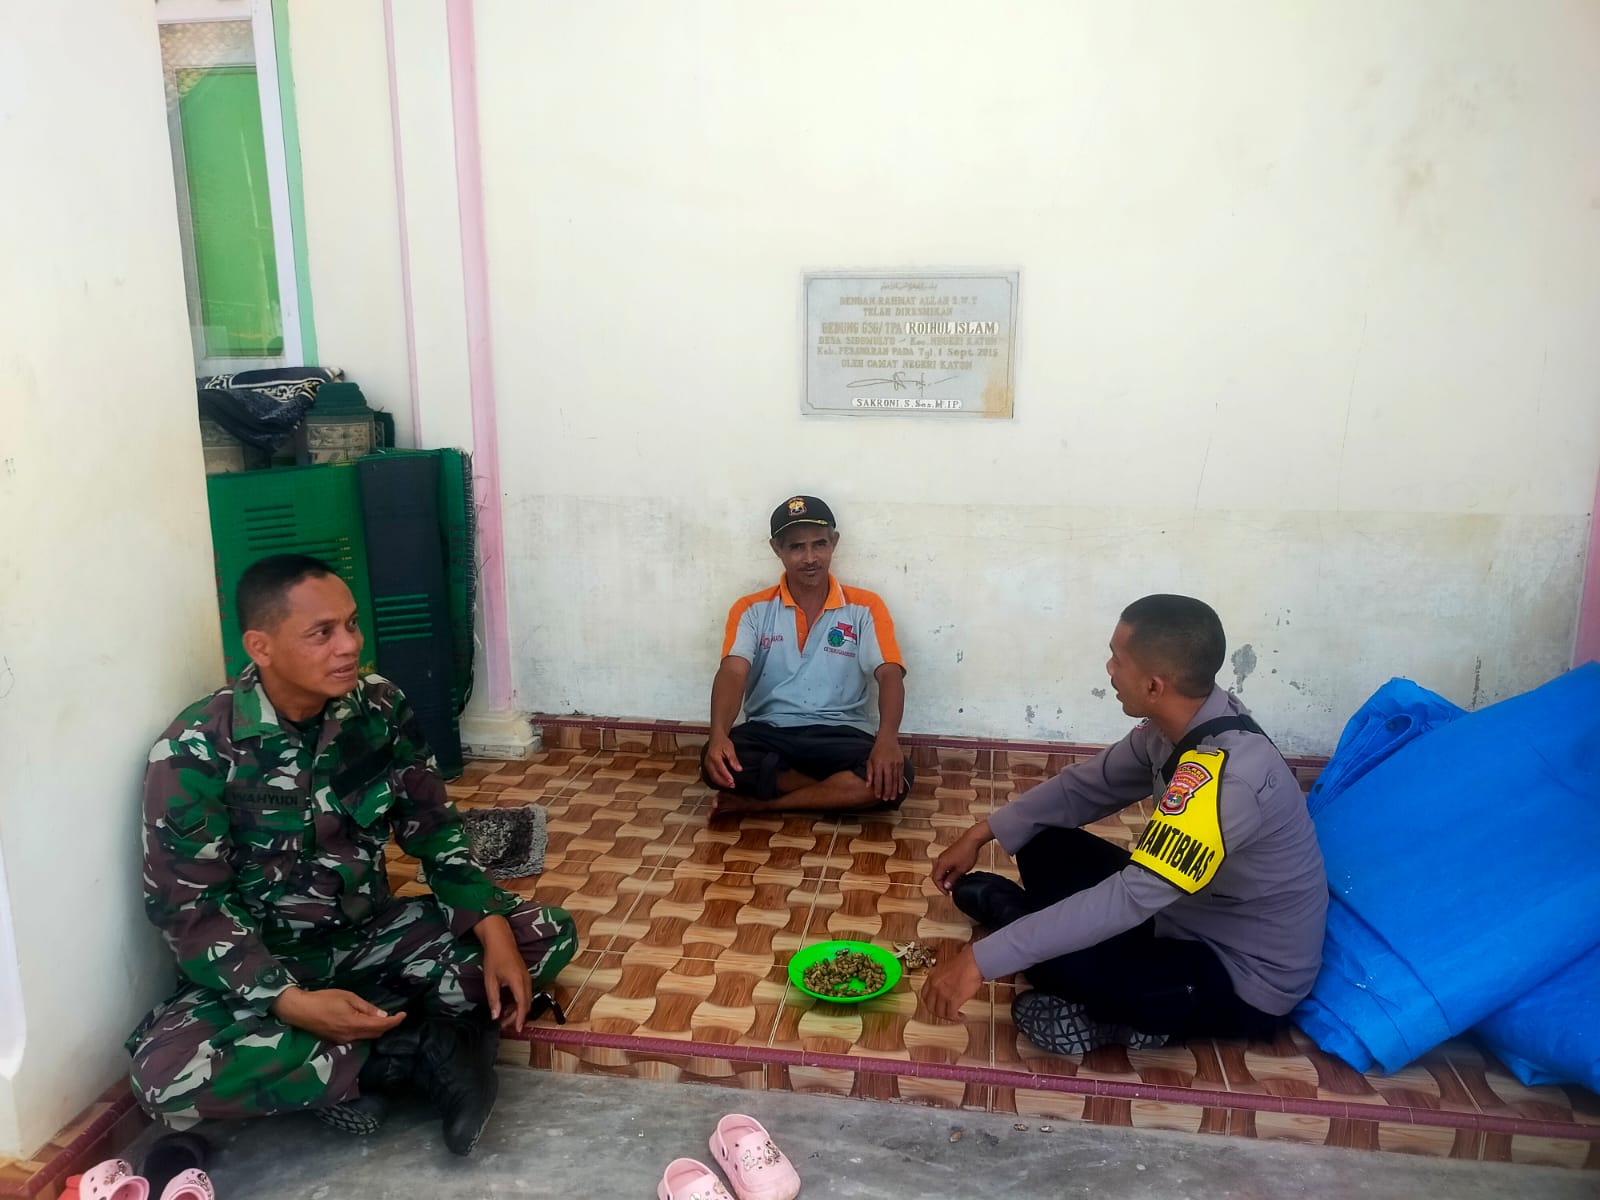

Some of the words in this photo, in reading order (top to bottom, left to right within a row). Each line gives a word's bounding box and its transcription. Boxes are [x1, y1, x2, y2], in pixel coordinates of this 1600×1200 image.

[863, 307, 891, 317] TELAH
[908, 322, 952, 335] ROIHUL
[955, 322, 996, 335] ISLAM
[818, 336, 842, 345] DESA
[891, 347, 914, 357] PADA
[866, 360, 898, 369] CAMAT
[231, 791, 299, 806] WAHYUDI
